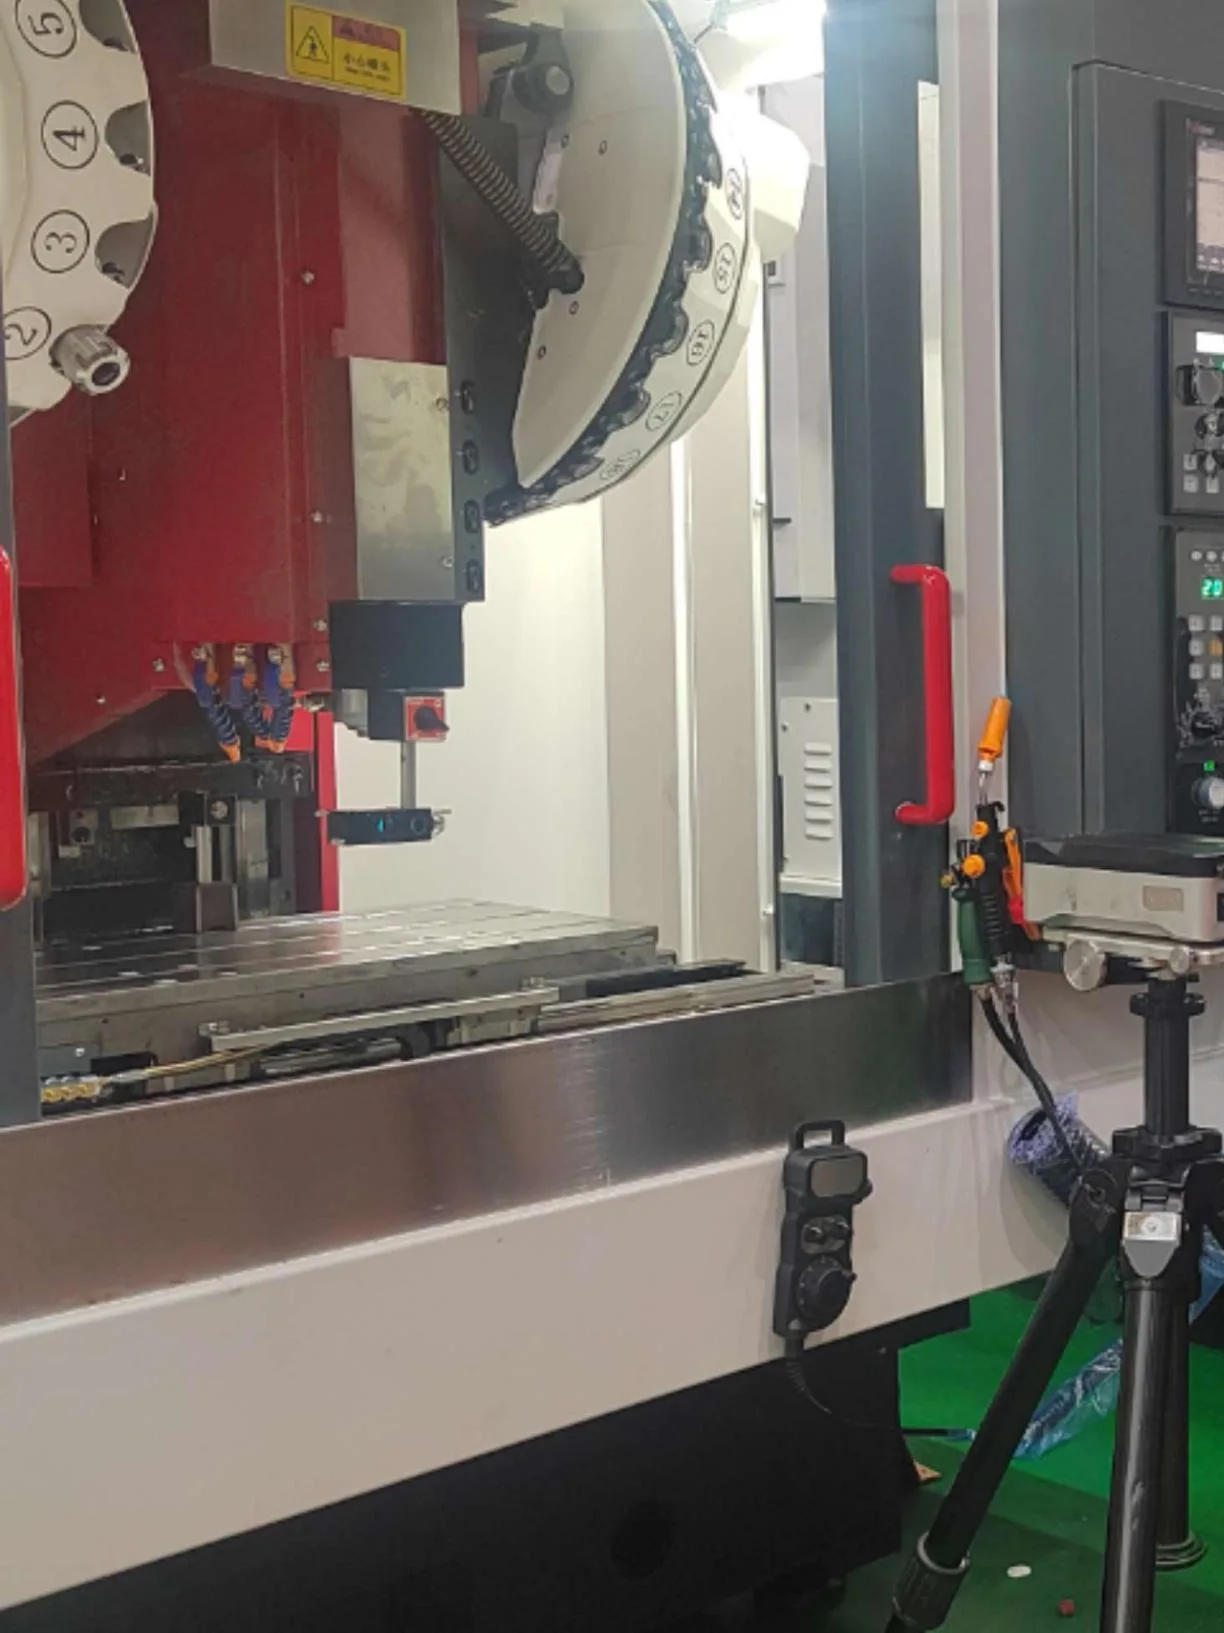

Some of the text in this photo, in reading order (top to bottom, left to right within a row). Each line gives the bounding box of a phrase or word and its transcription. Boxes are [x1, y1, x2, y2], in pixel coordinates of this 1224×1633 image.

[28, 12, 65, 36] 5
[52, 125, 87, 152] 4
[45, 231, 78, 254] 3
[716, 253, 732, 282] 15
[4, 324, 38, 347] 2
[691, 329, 709, 357] 16
